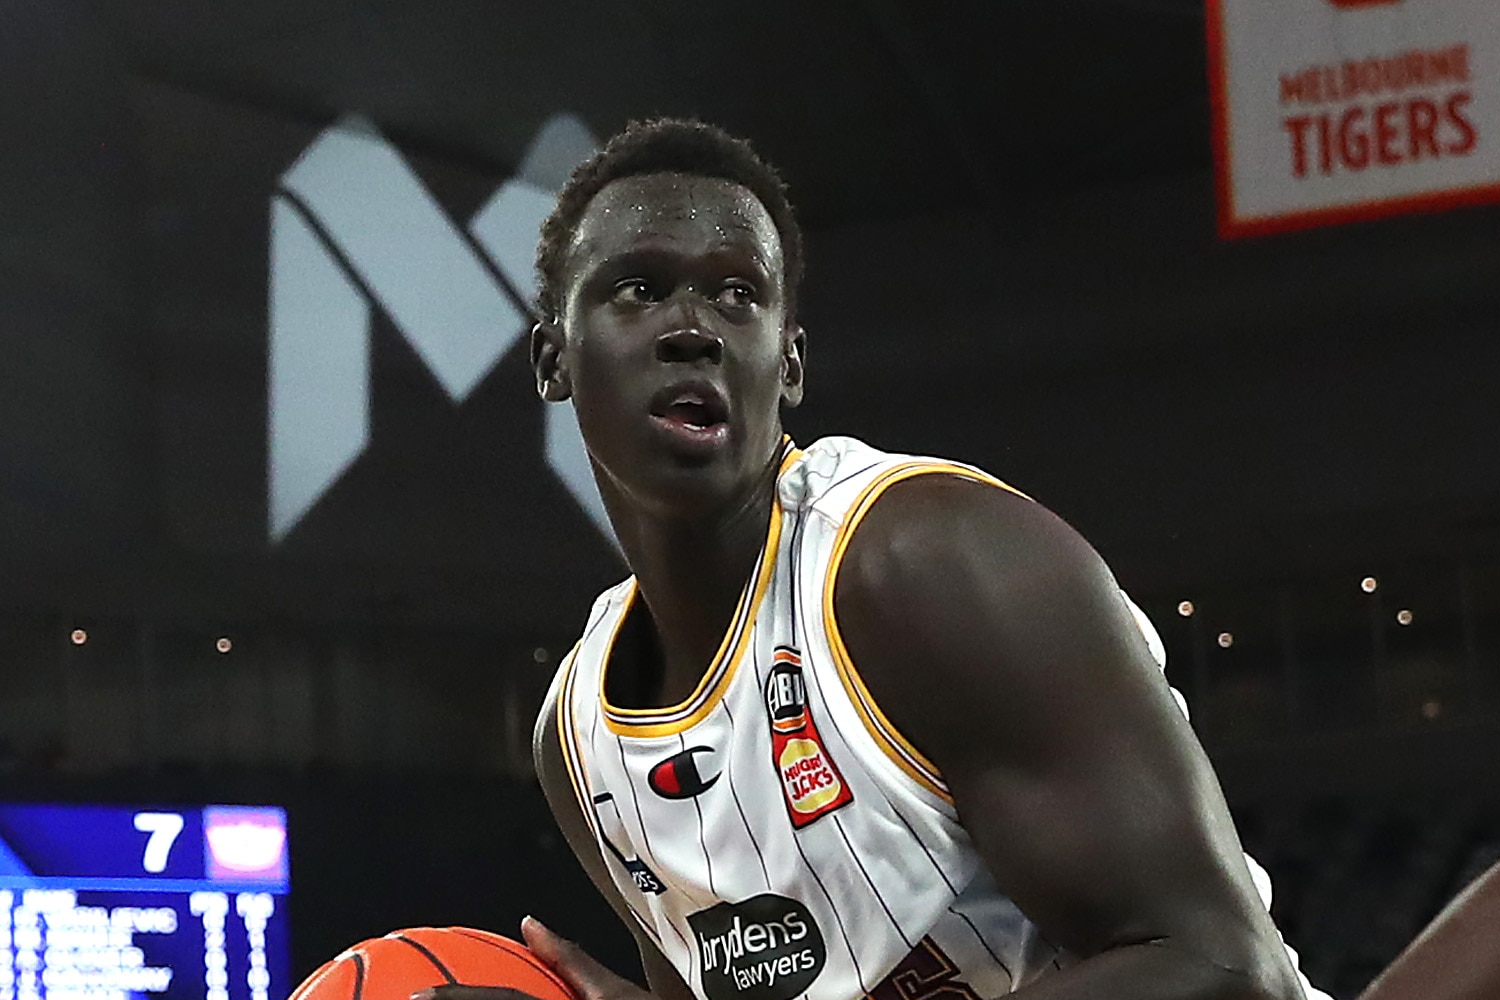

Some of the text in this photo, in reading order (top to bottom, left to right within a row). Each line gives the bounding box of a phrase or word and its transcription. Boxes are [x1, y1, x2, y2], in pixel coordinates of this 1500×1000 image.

[1284, 92, 1479, 179] TIGERS
[133, 811, 185, 874] 7
[700, 911, 808, 975] brydens
[732, 949, 816, 991] lawyers
